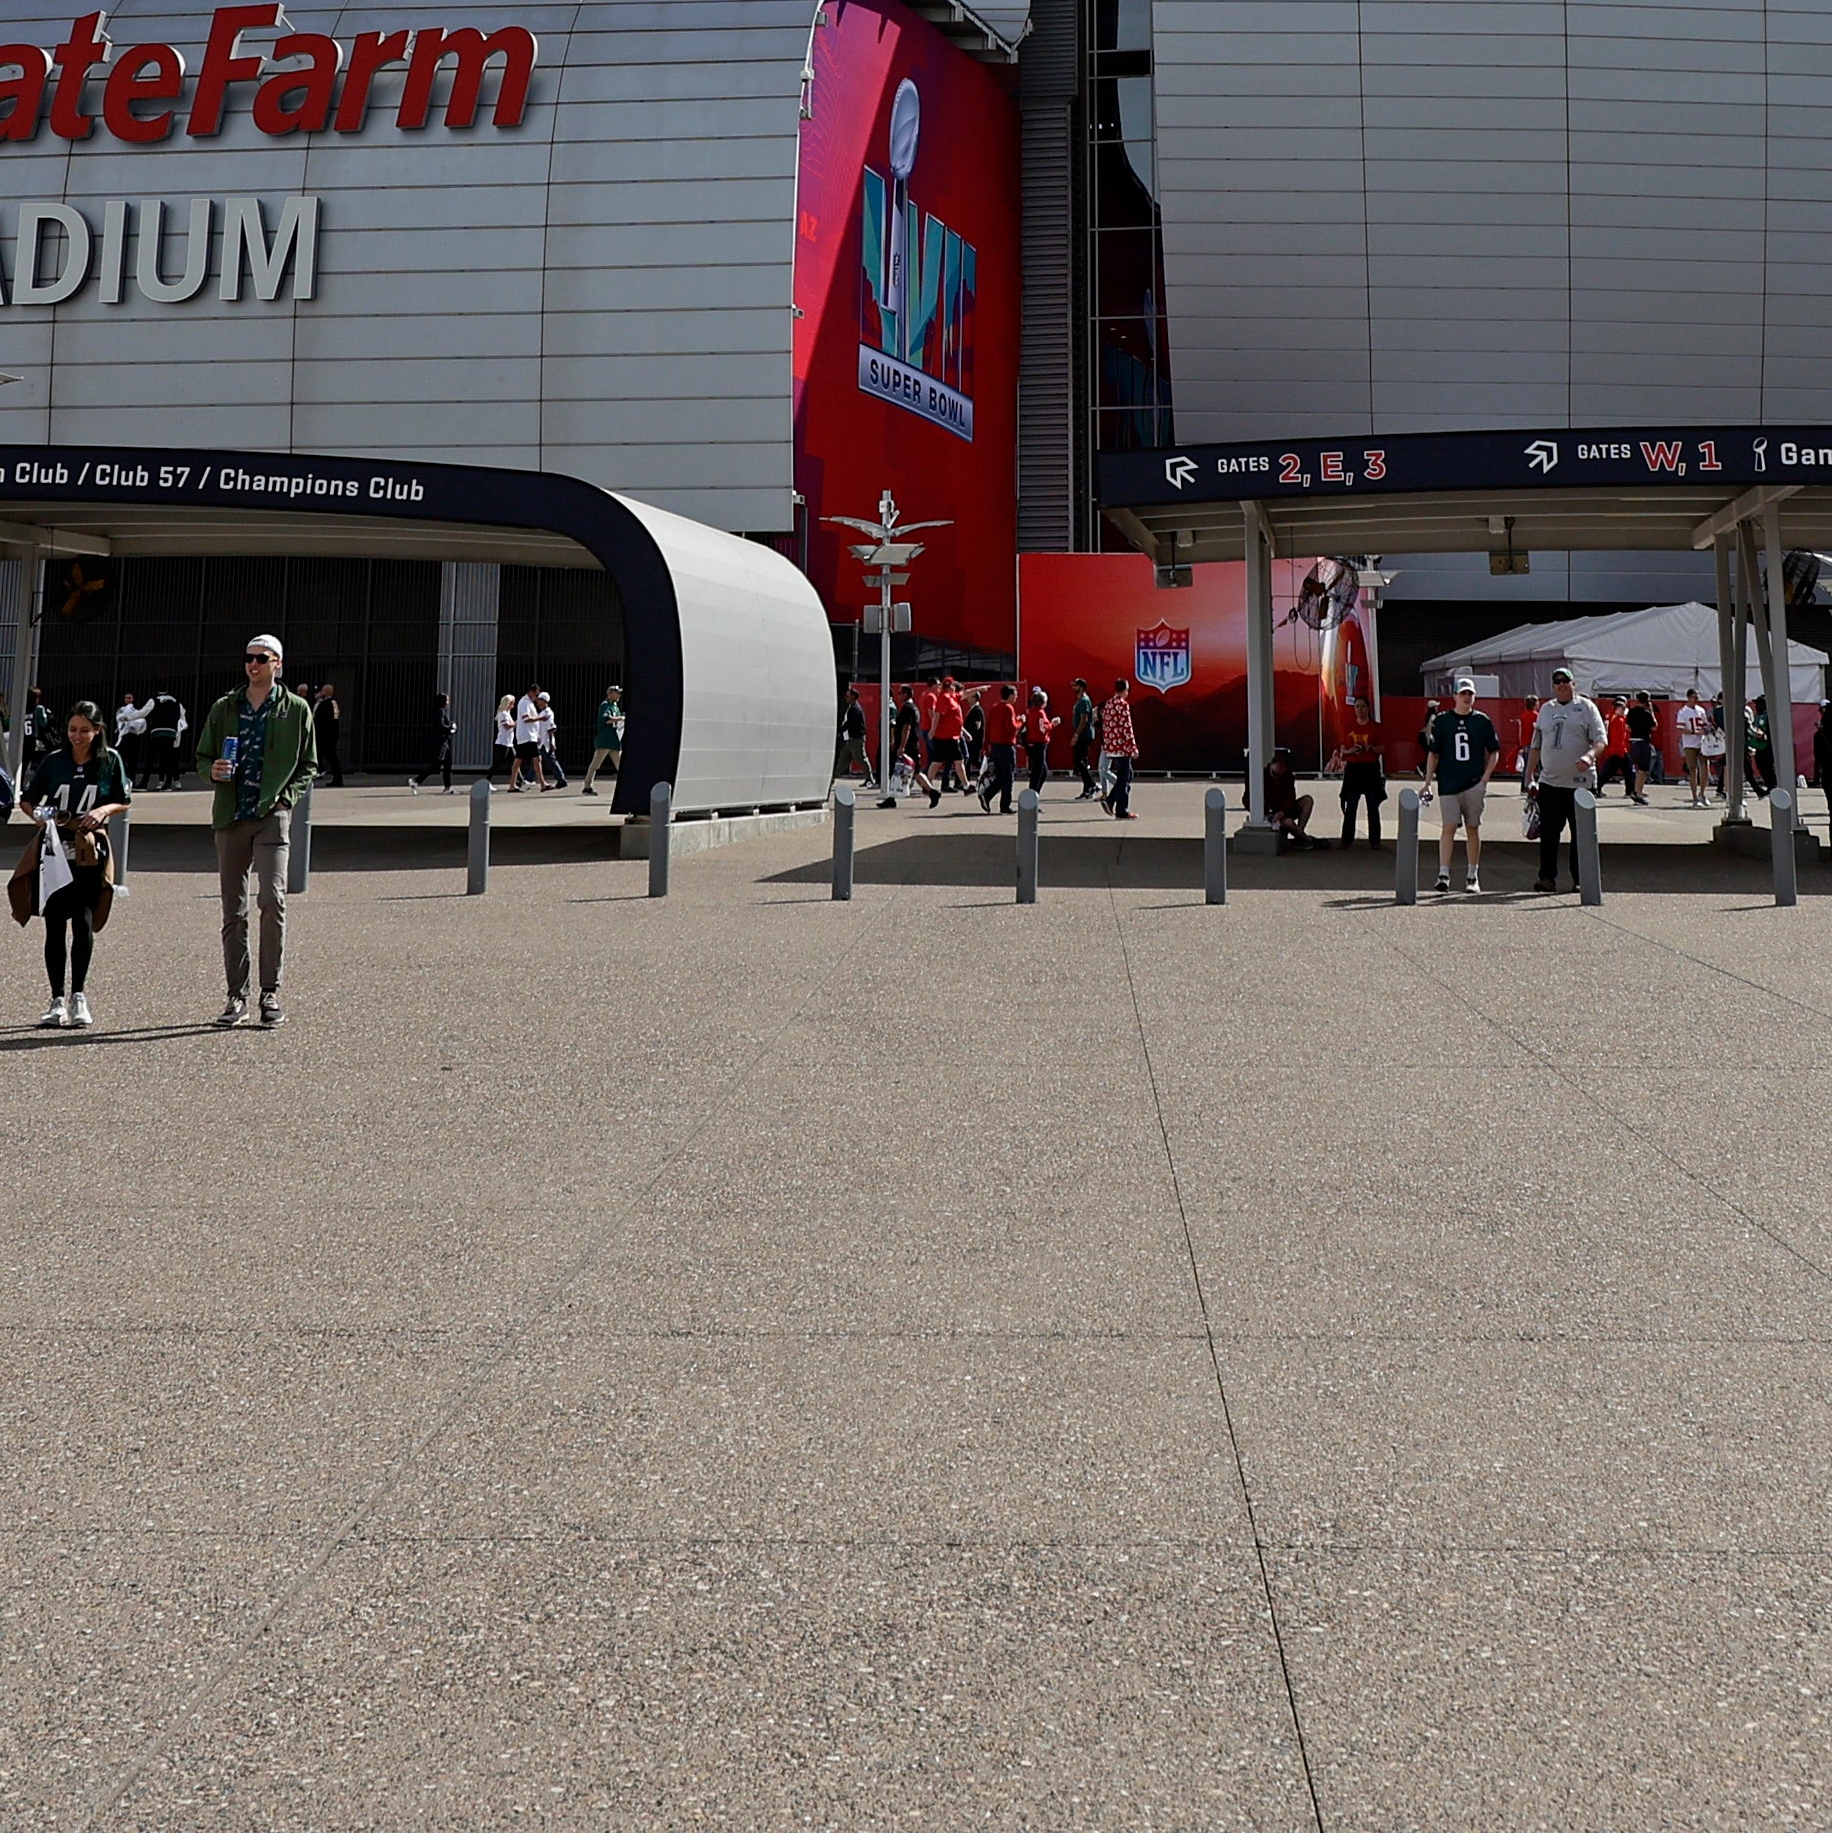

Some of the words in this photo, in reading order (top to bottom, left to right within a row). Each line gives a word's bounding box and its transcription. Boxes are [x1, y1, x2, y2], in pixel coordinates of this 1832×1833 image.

[869, 358, 922, 406] SUPER
[928, 387, 966, 429] BOWL
[1217, 456, 1270, 474] GATES
[1279, 453, 1311, 487] 2,
[1320, 451, 1354, 486] E,
[1364, 450, 1386, 480] 3
[1578, 443, 1631, 459] GATES
[1639, 441, 1687, 476] W,
[1698, 440, 1722, 470] 1
[15, 462, 69, 485] Club
[95, 464, 149, 487] Club
[158, 466, 190, 488] 57
[219, 468, 359, 498] Champions
[369, 477, 424, 502] Club
[1141, 651, 1185, 682] NFL
[1454, 732, 1470, 762] 6
